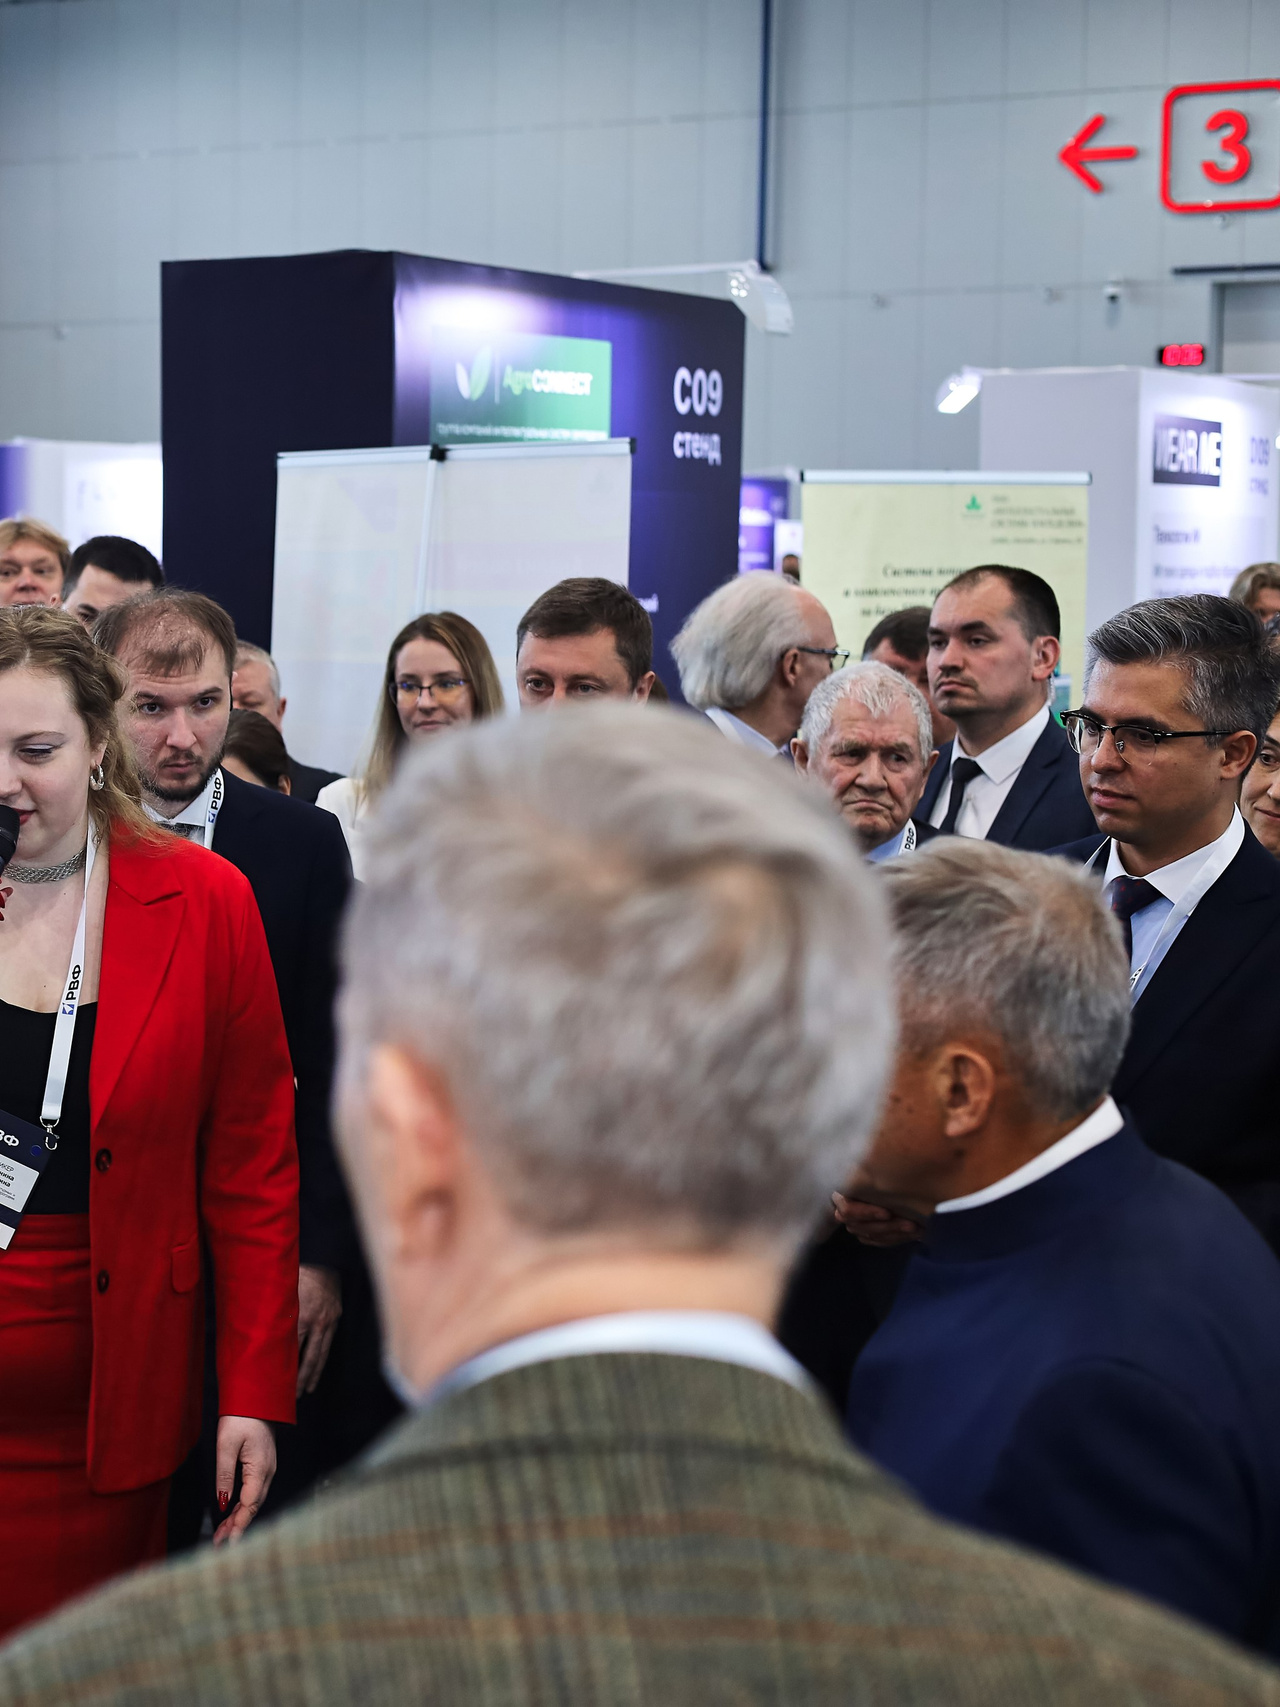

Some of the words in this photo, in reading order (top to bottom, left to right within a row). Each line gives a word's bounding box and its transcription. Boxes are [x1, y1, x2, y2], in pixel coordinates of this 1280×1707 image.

[1202, 108, 1251, 185] 3
[673, 431, 722, 466] стенд
[211, 777, 222, 810] РВФ
[65, 964, 81, 1000] РВФ
